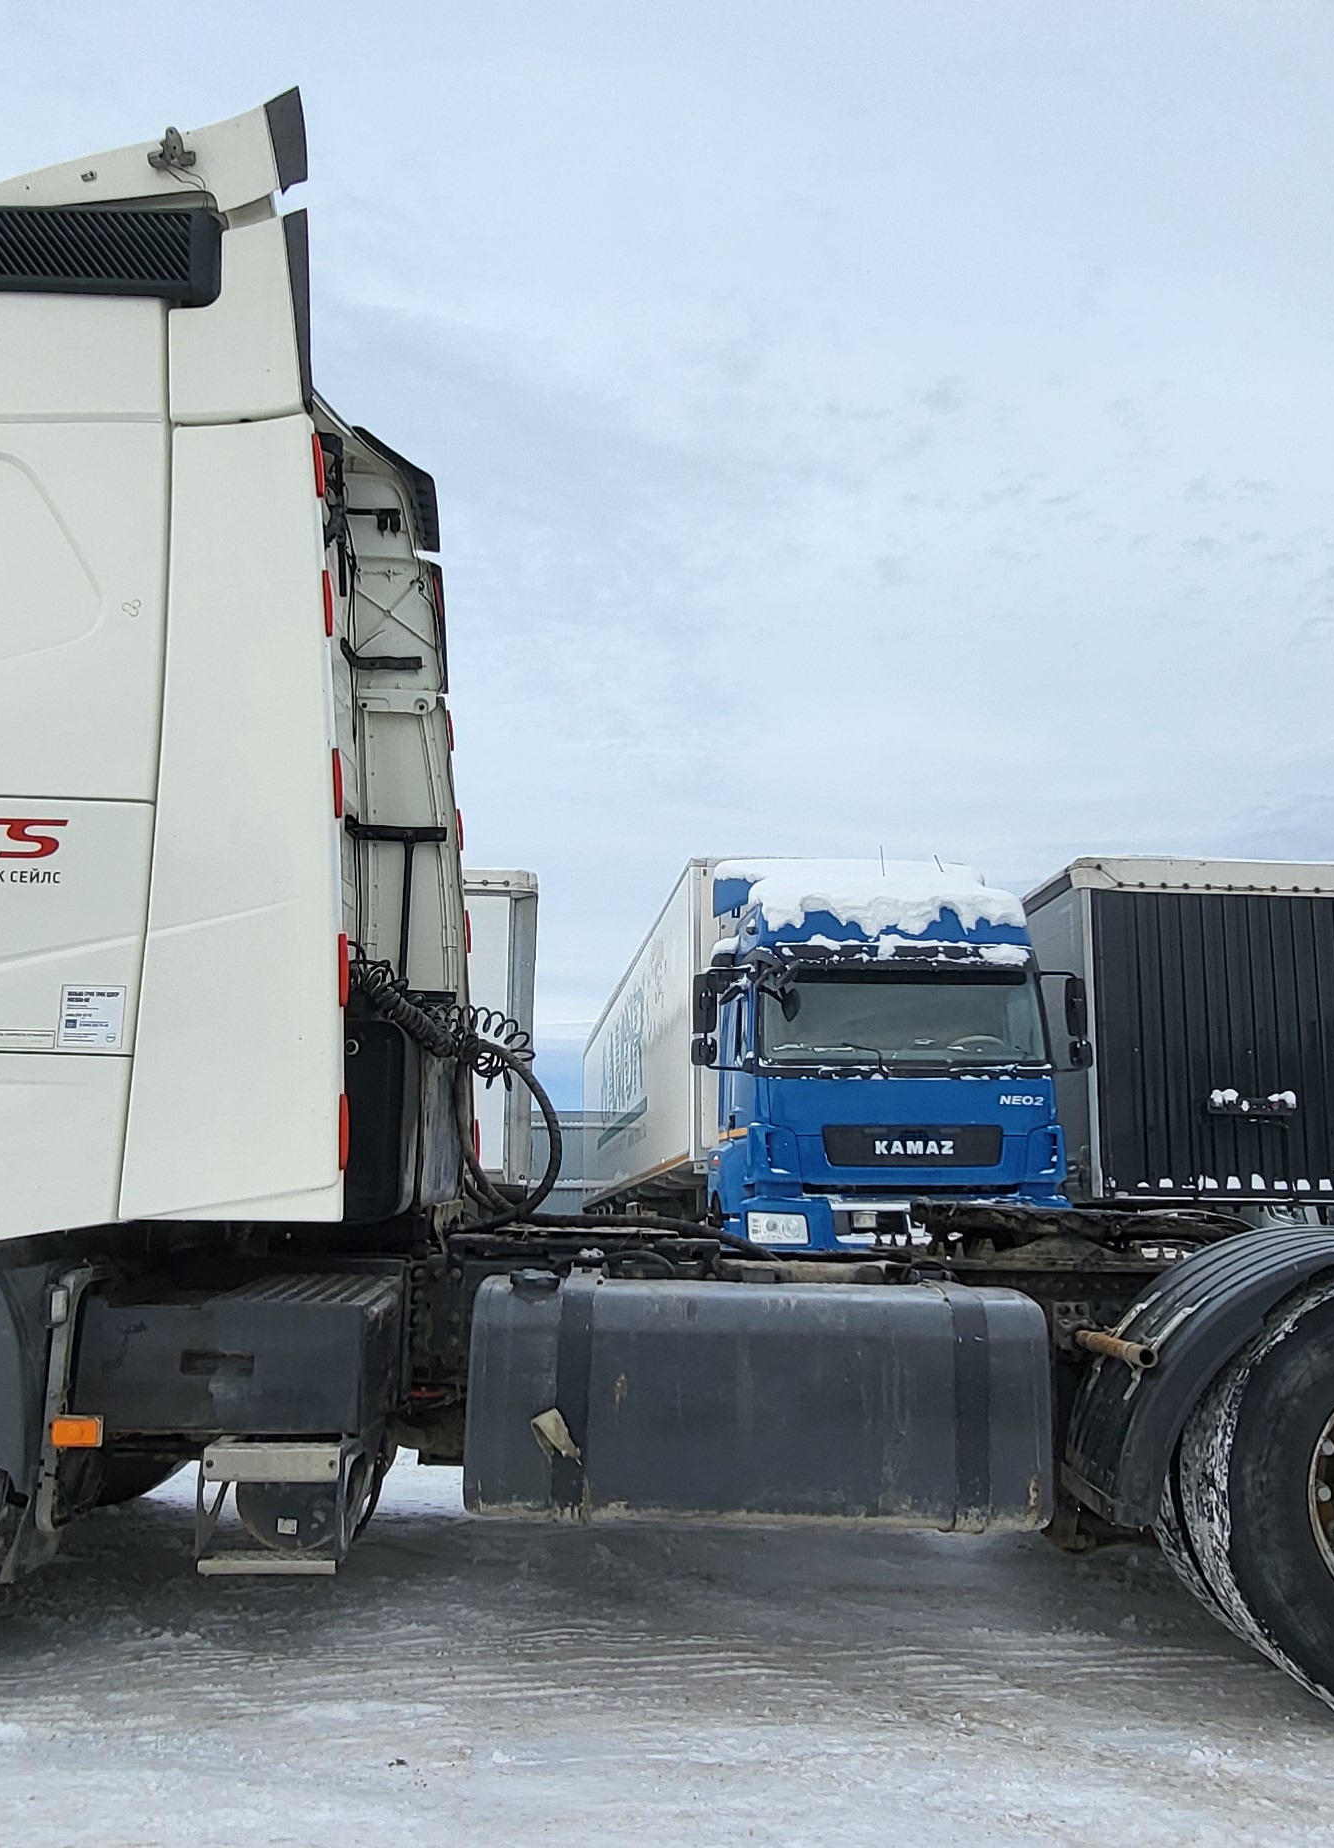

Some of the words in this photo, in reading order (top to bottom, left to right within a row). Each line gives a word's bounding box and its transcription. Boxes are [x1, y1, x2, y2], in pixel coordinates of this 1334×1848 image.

[10, 868, 62, 884] СЕЙЛС
[999, 1095, 1044, 1106] NEO2
[874, 1140, 954, 1155] KAMAZ
